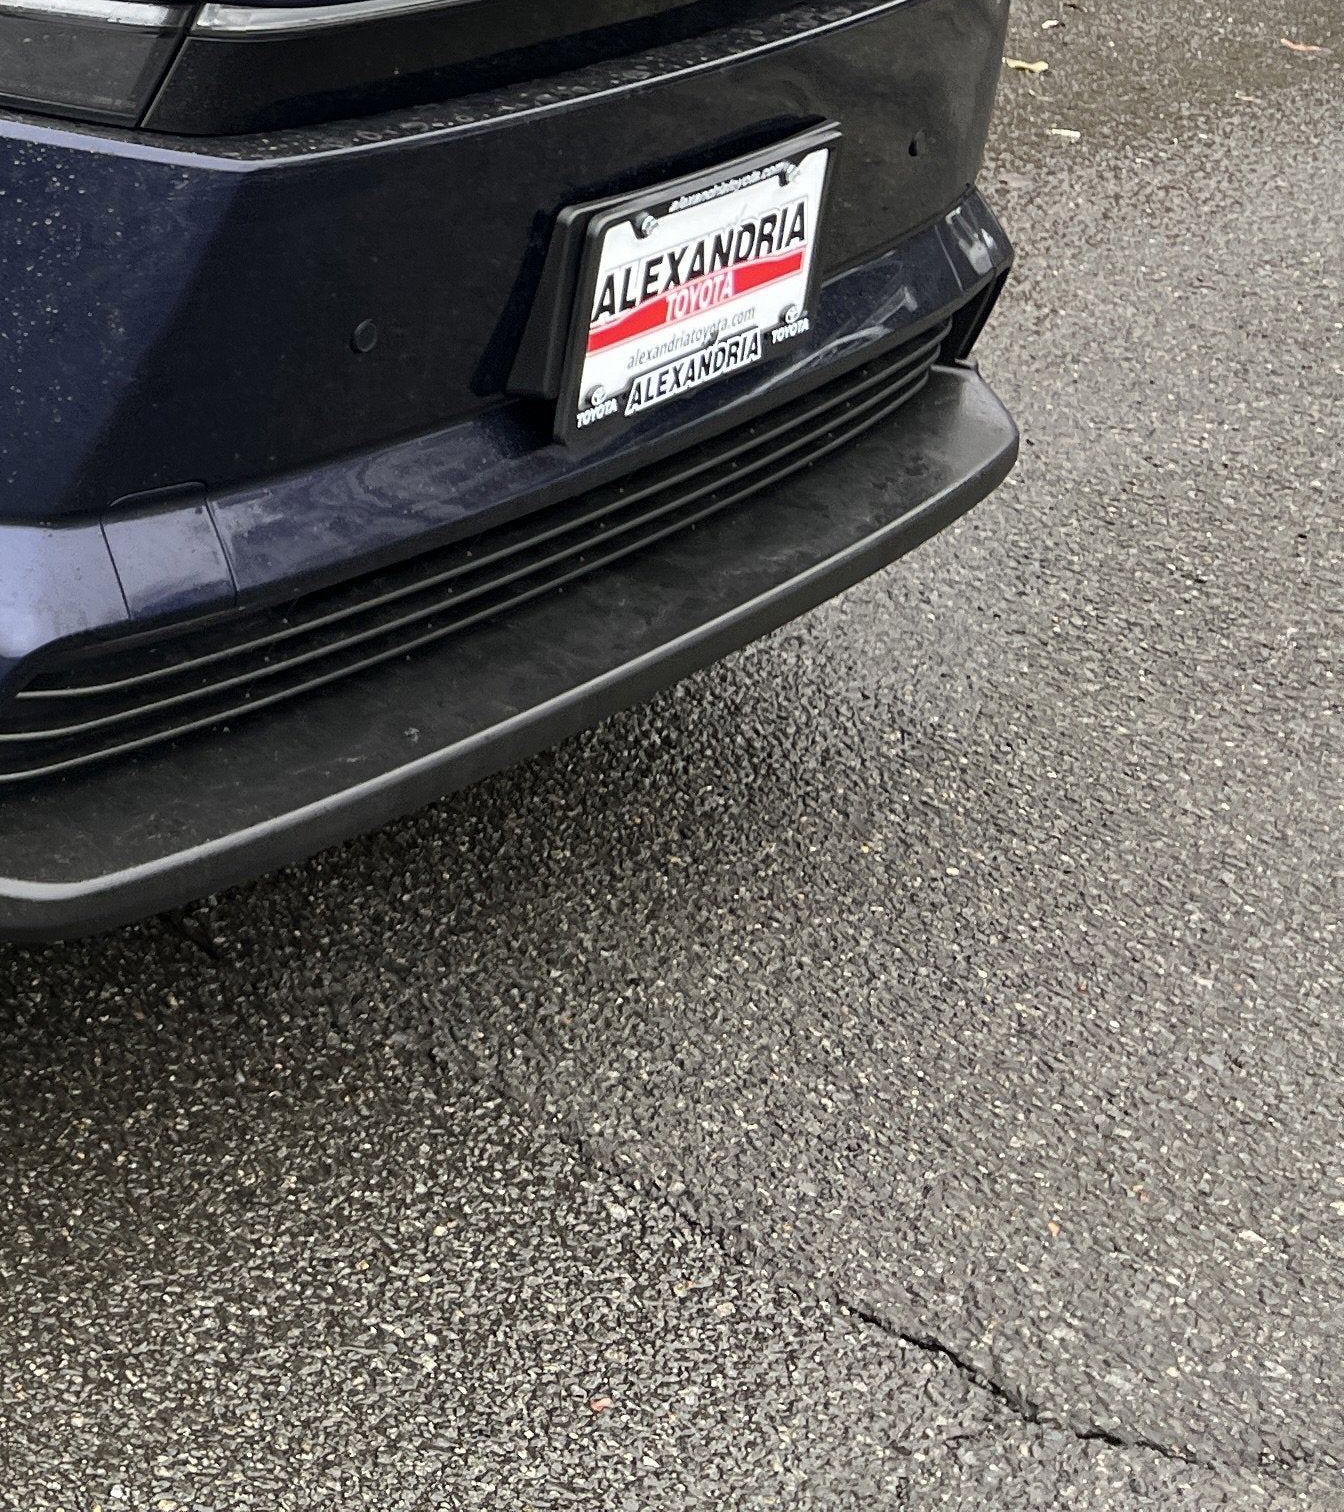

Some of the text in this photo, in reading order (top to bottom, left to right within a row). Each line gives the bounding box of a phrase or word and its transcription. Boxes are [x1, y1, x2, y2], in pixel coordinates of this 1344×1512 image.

[592, 200, 806, 323] ALEXANDRIA
[665, 271, 734, 322] TOYOTA
[627, 306, 756, 369] alexandriatoyota.com
[771, 318, 810, 345] TOYOTA
[626, 329, 760, 414] ALEXANDRIA
[576, 398, 618, 429] TOYOTA
